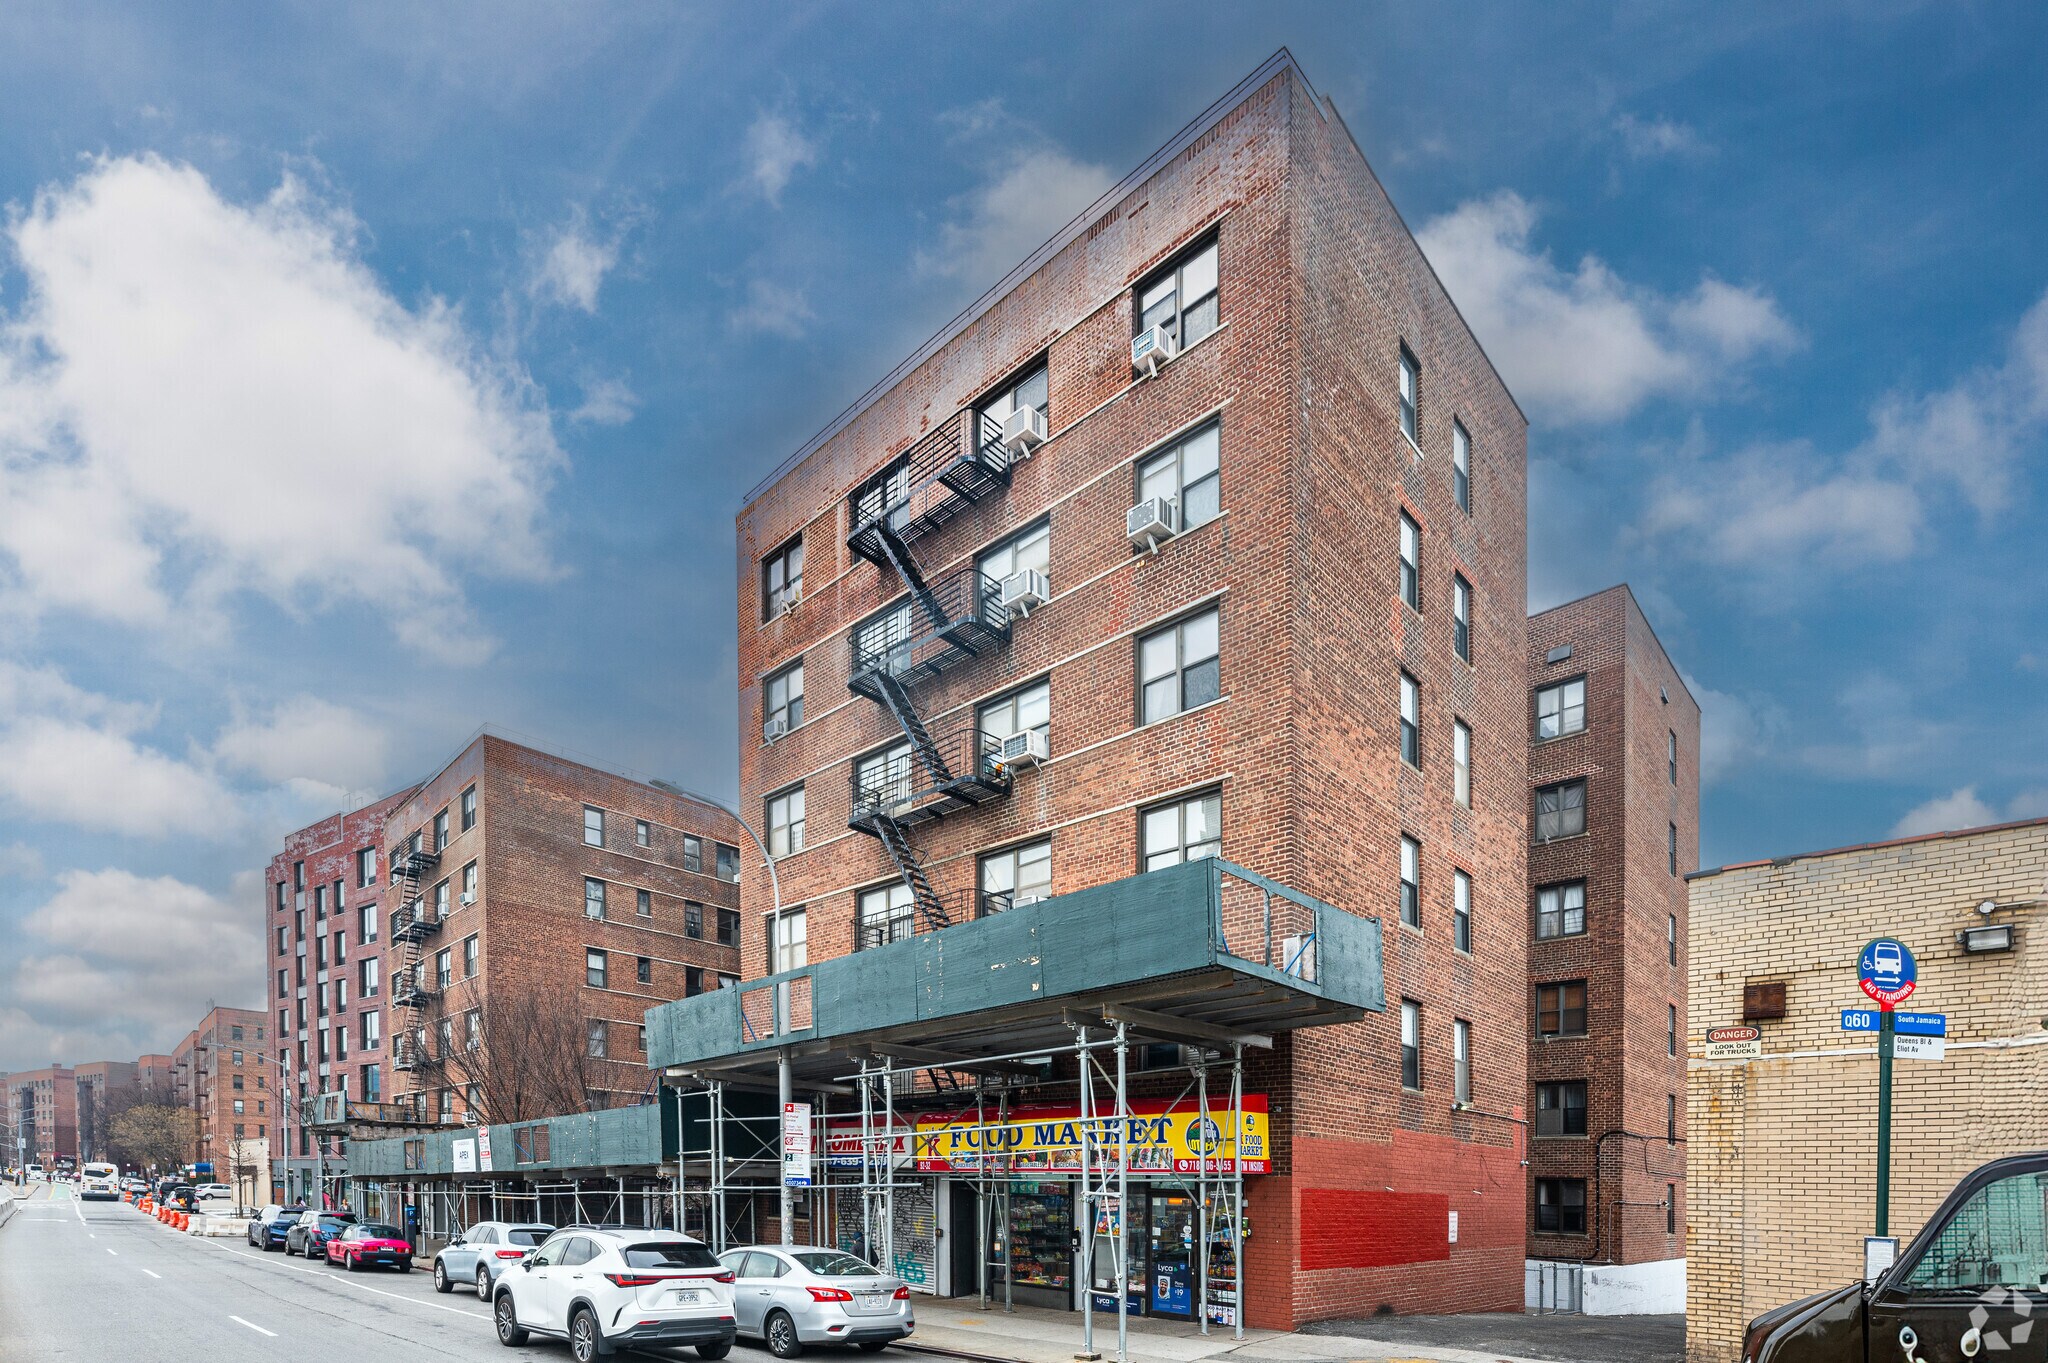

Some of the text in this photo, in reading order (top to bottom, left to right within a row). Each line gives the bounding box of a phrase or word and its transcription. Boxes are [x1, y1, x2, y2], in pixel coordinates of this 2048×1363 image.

[1865, 981, 1913, 1000] NO STANDING
[1844, 1013, 1870, 1028] Q60
[1897, 1015, 1941, 1025] South Jamaica
[1713, 1030, 1753, 1039] DANGER
[1897, 1036, 1919, 1045] Queens
[1927, 1038, 1932, 1046] &
[1896, 1045, 1910, 1053] Eliot
[950, 1123, 1024, 1148] FOOD
[1245, 1134, 1263, 1145] FOOD
[1248, 1161, 1264, 1172] INSIDE
[1157, 1264, 1174, 1273] Lyca
[1096, 1296, 1110, 1306] Lyca
